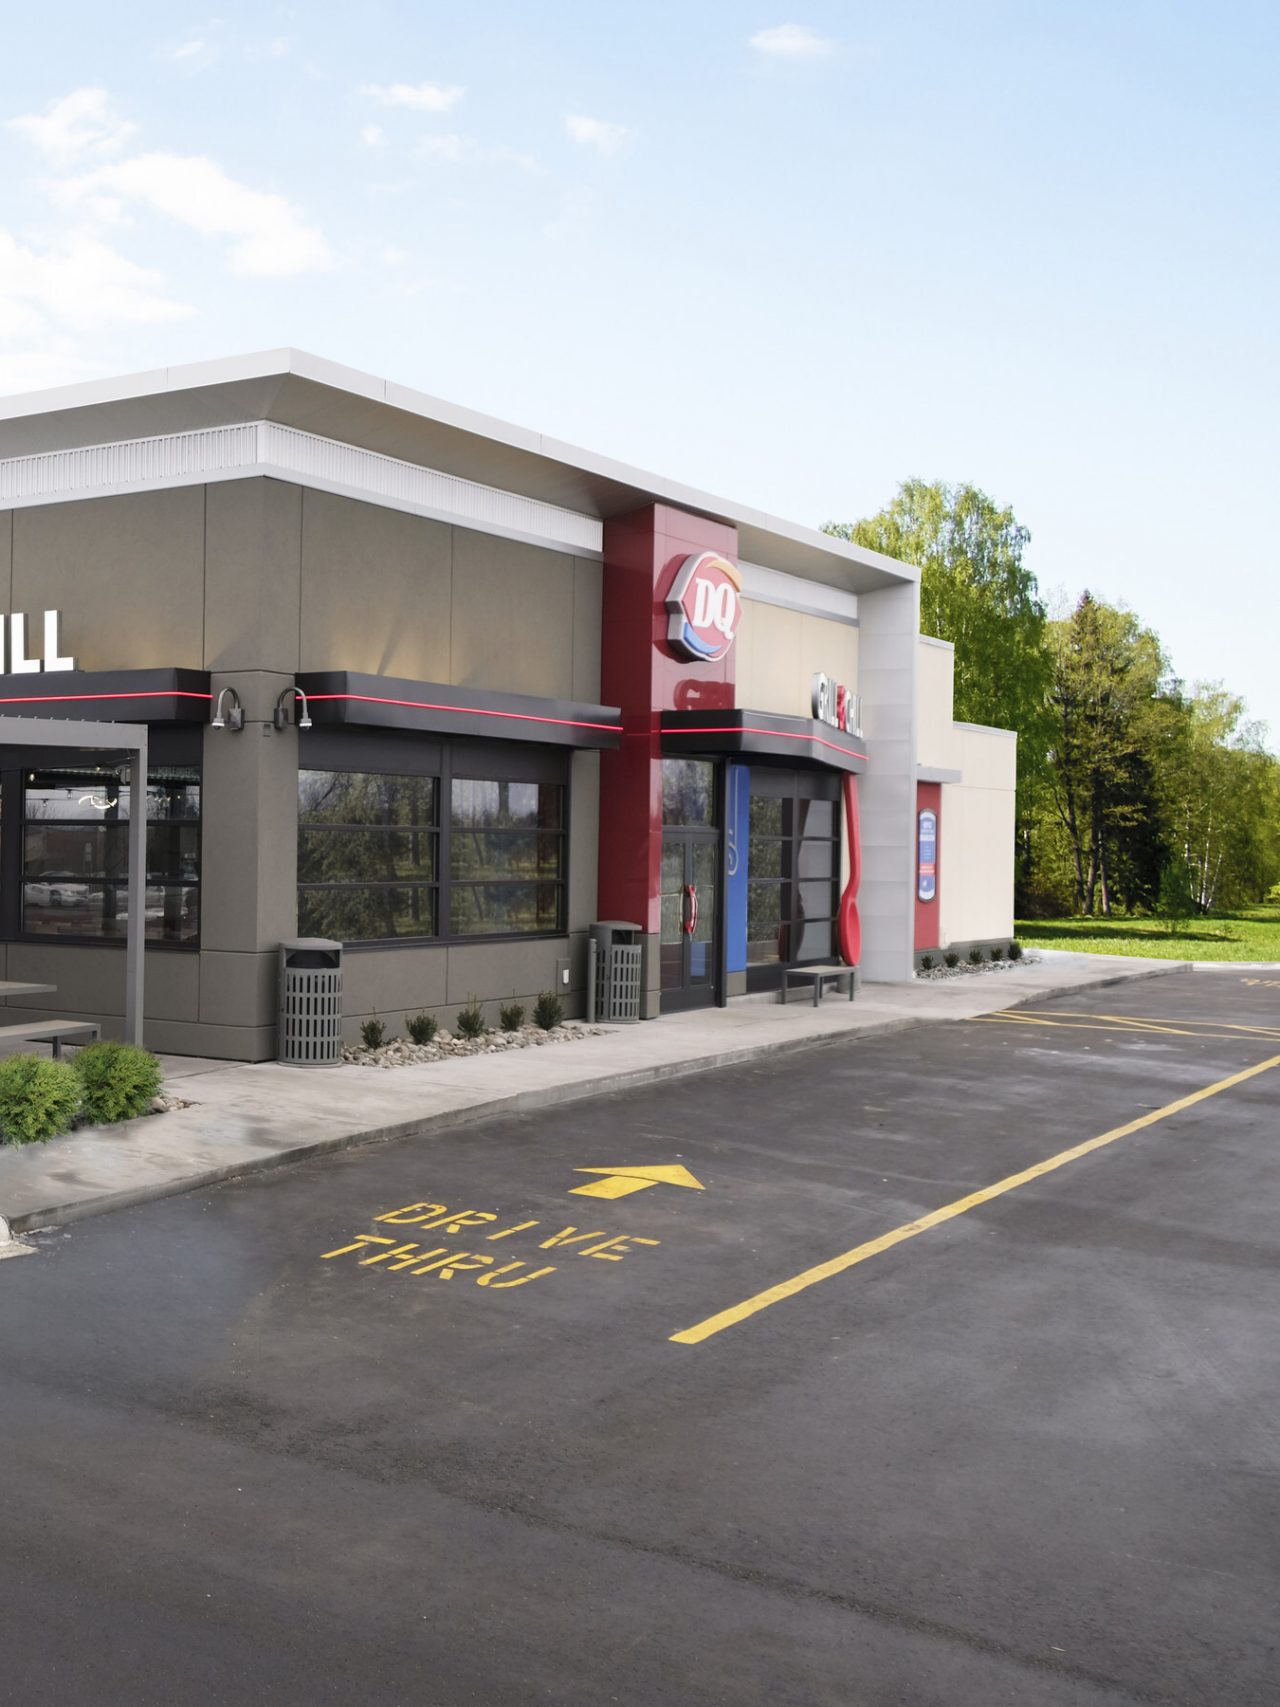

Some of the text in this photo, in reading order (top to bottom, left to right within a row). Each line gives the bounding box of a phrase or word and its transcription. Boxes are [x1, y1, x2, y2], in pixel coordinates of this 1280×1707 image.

[692, 577, 736, 640] DQ
[373, 1203, 661, 1261] DRIVE
[320, 1235, 558, 1288] THRU
